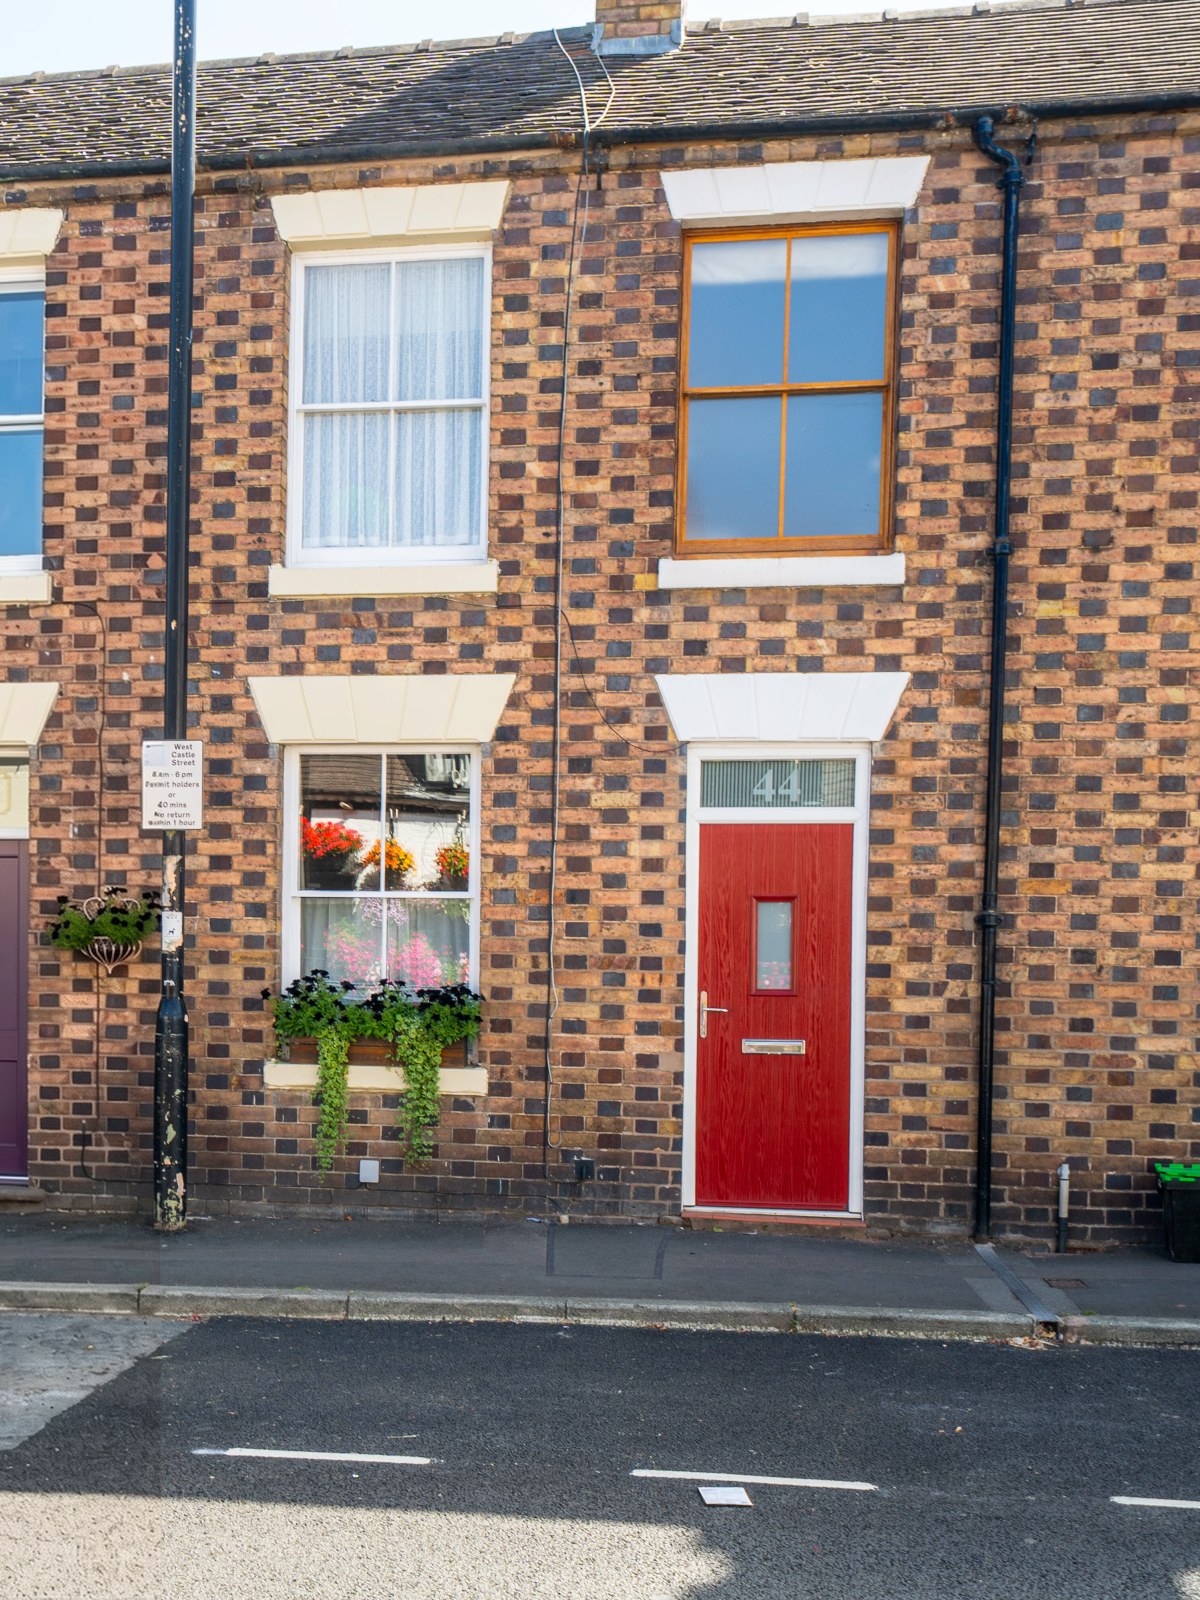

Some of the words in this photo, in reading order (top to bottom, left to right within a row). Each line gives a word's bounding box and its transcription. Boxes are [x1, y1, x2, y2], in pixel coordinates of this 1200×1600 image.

[145, 780, 170, 788] Permit
[172, 780, 200, 788] holders
[752, 768, 802, 802] 44
